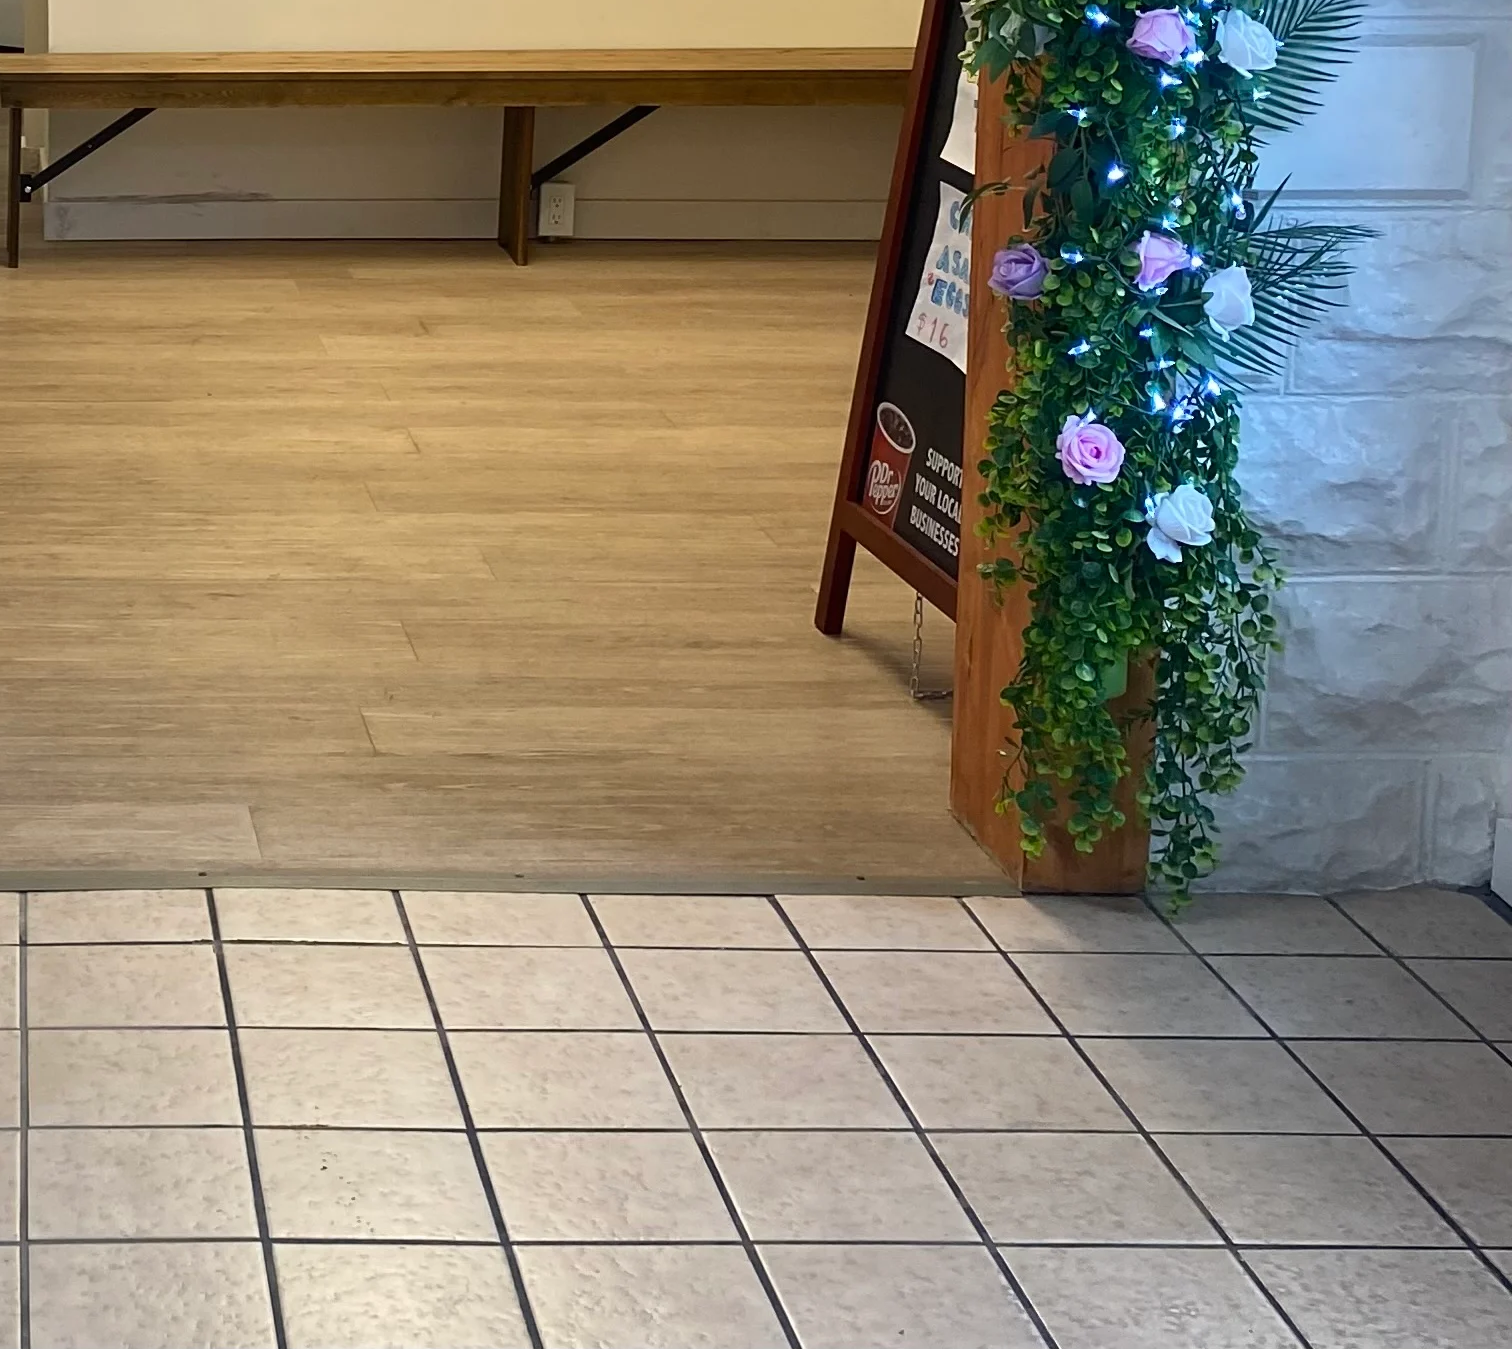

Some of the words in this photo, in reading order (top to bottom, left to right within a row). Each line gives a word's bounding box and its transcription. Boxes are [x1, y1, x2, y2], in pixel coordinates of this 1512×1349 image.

[916, 312, 950, 349] $16
[868, 460, 899, 506] Pepper
[879, 462, 894, 485] Dr
[925, 447, 963, 490] SUPPORT
[914, 472, 937, 506] YOUR
[909, 504, 960, 557] BUSINESSES
